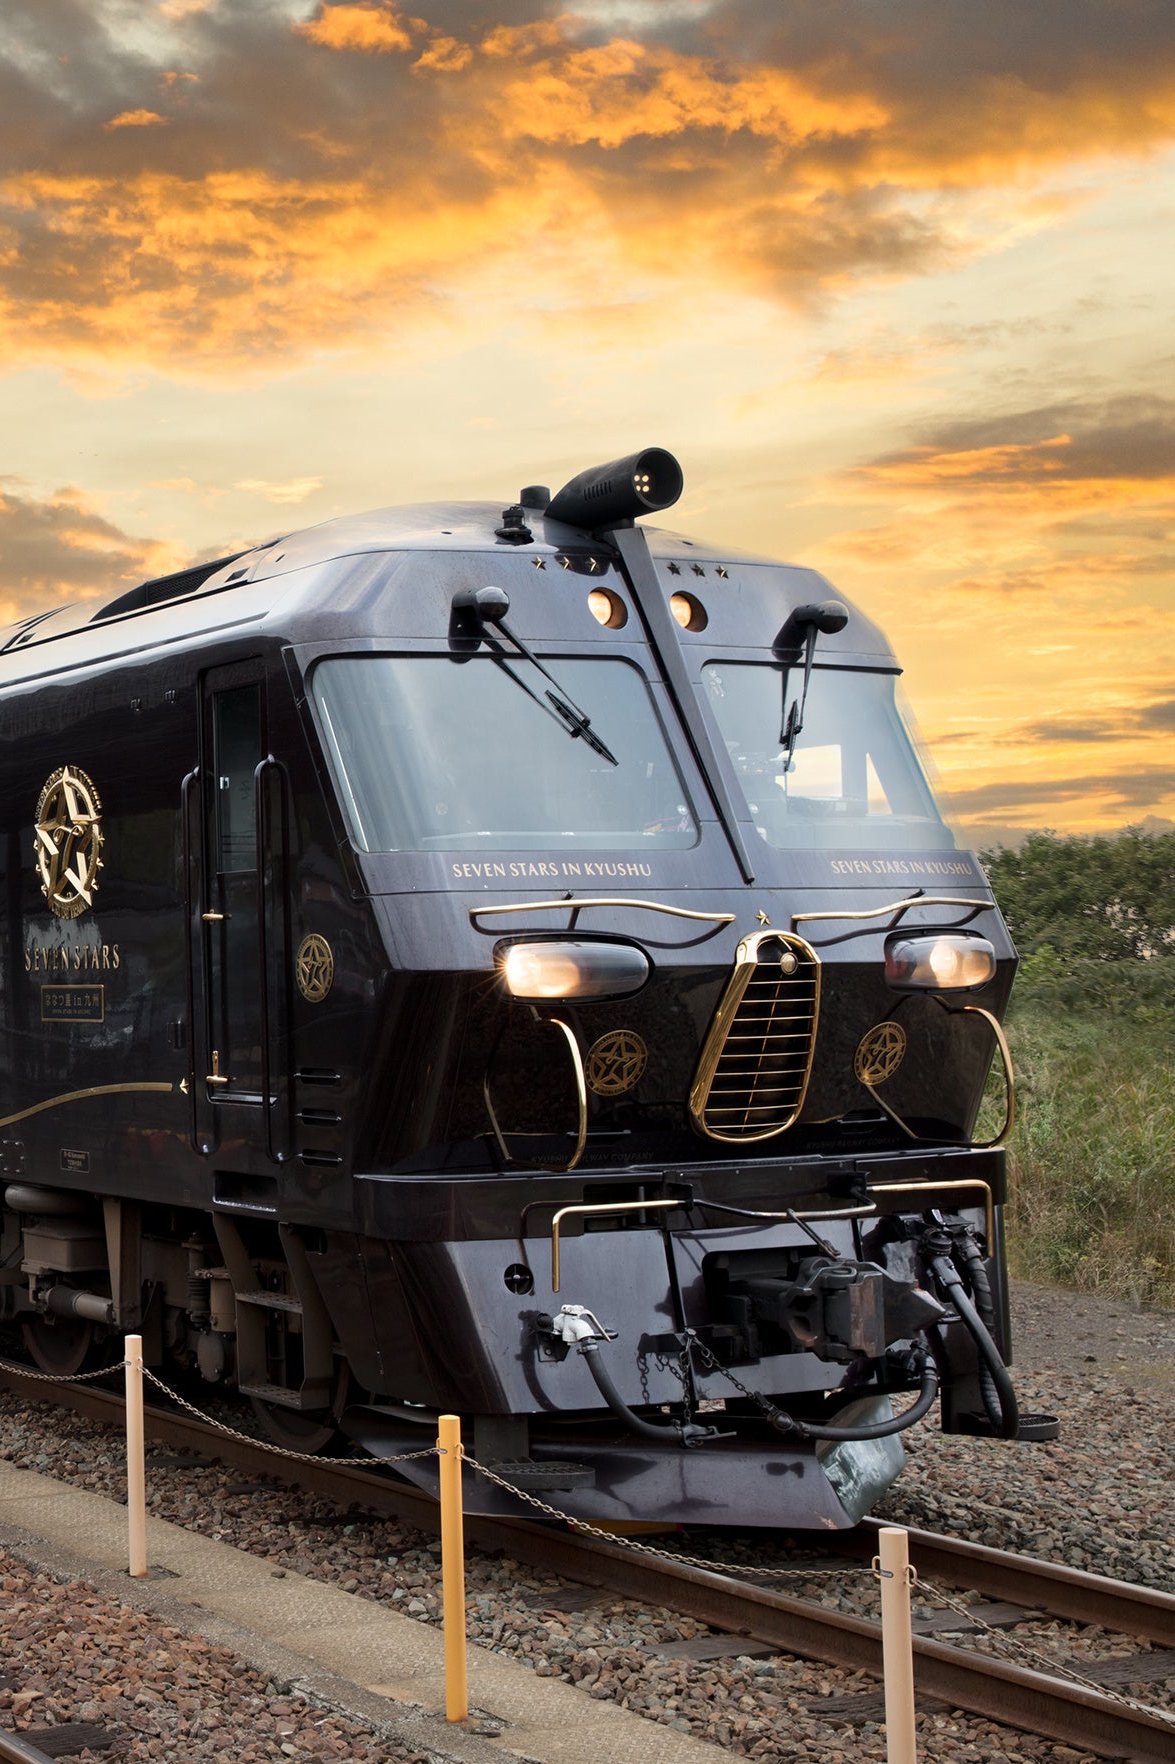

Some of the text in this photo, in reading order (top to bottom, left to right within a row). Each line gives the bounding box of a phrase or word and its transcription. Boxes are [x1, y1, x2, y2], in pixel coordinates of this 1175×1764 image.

[452, 862, 652, 878] SEVEN STARS IN KYUSHU
[830, 860, 973, 875] SEVEN STARS IN KYUSHU
[25, 944, 121, 972] SEVEN STARS
